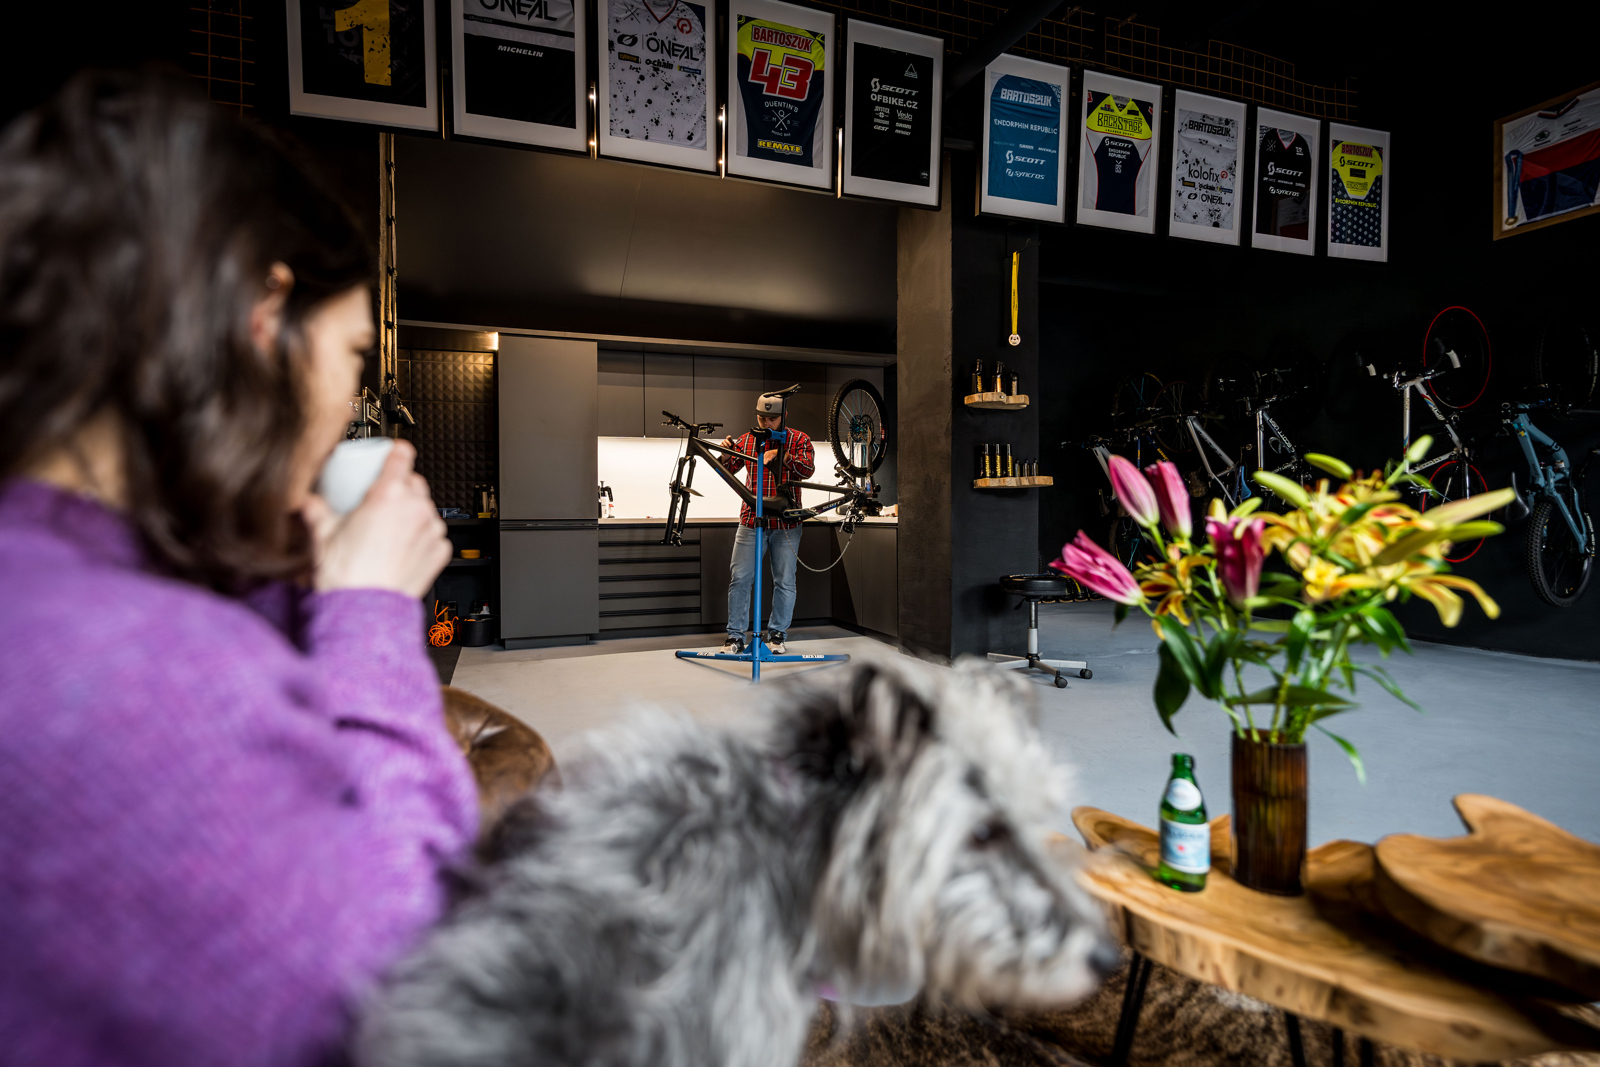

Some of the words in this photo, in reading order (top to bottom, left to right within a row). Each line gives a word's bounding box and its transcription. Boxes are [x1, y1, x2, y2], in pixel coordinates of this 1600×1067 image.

[752, 26, 812, 52] BARTOSZUK
[498, 45, 544, 58] MICHELIN
[748, 48, 814, 100] 43
[880, 84, 919, 96] SCOTT
[764, 100, 799, 113] QUENTIN'S
[870, 93, 919, 110] OFBIKE.CZ
[994, 118, 1029, 129] ENDORPHIN
[1030, 123, 1058, 134] REPUBLIC
[1098, 113, 1142, 133] BACKSTAGE
[758, 140, 801, 152] REMATE
[1341, 144, 1373, 158] BARTOSZUK
[1014, 156, 1046, 165] SCOTT
[1346, 160, 1375, 168] SCOTT
[1188, 164, 1220, 182] kolofix
[1275, 167, 1304, 177] SCOTT
[822, 500, 841, 510] SCOTT
